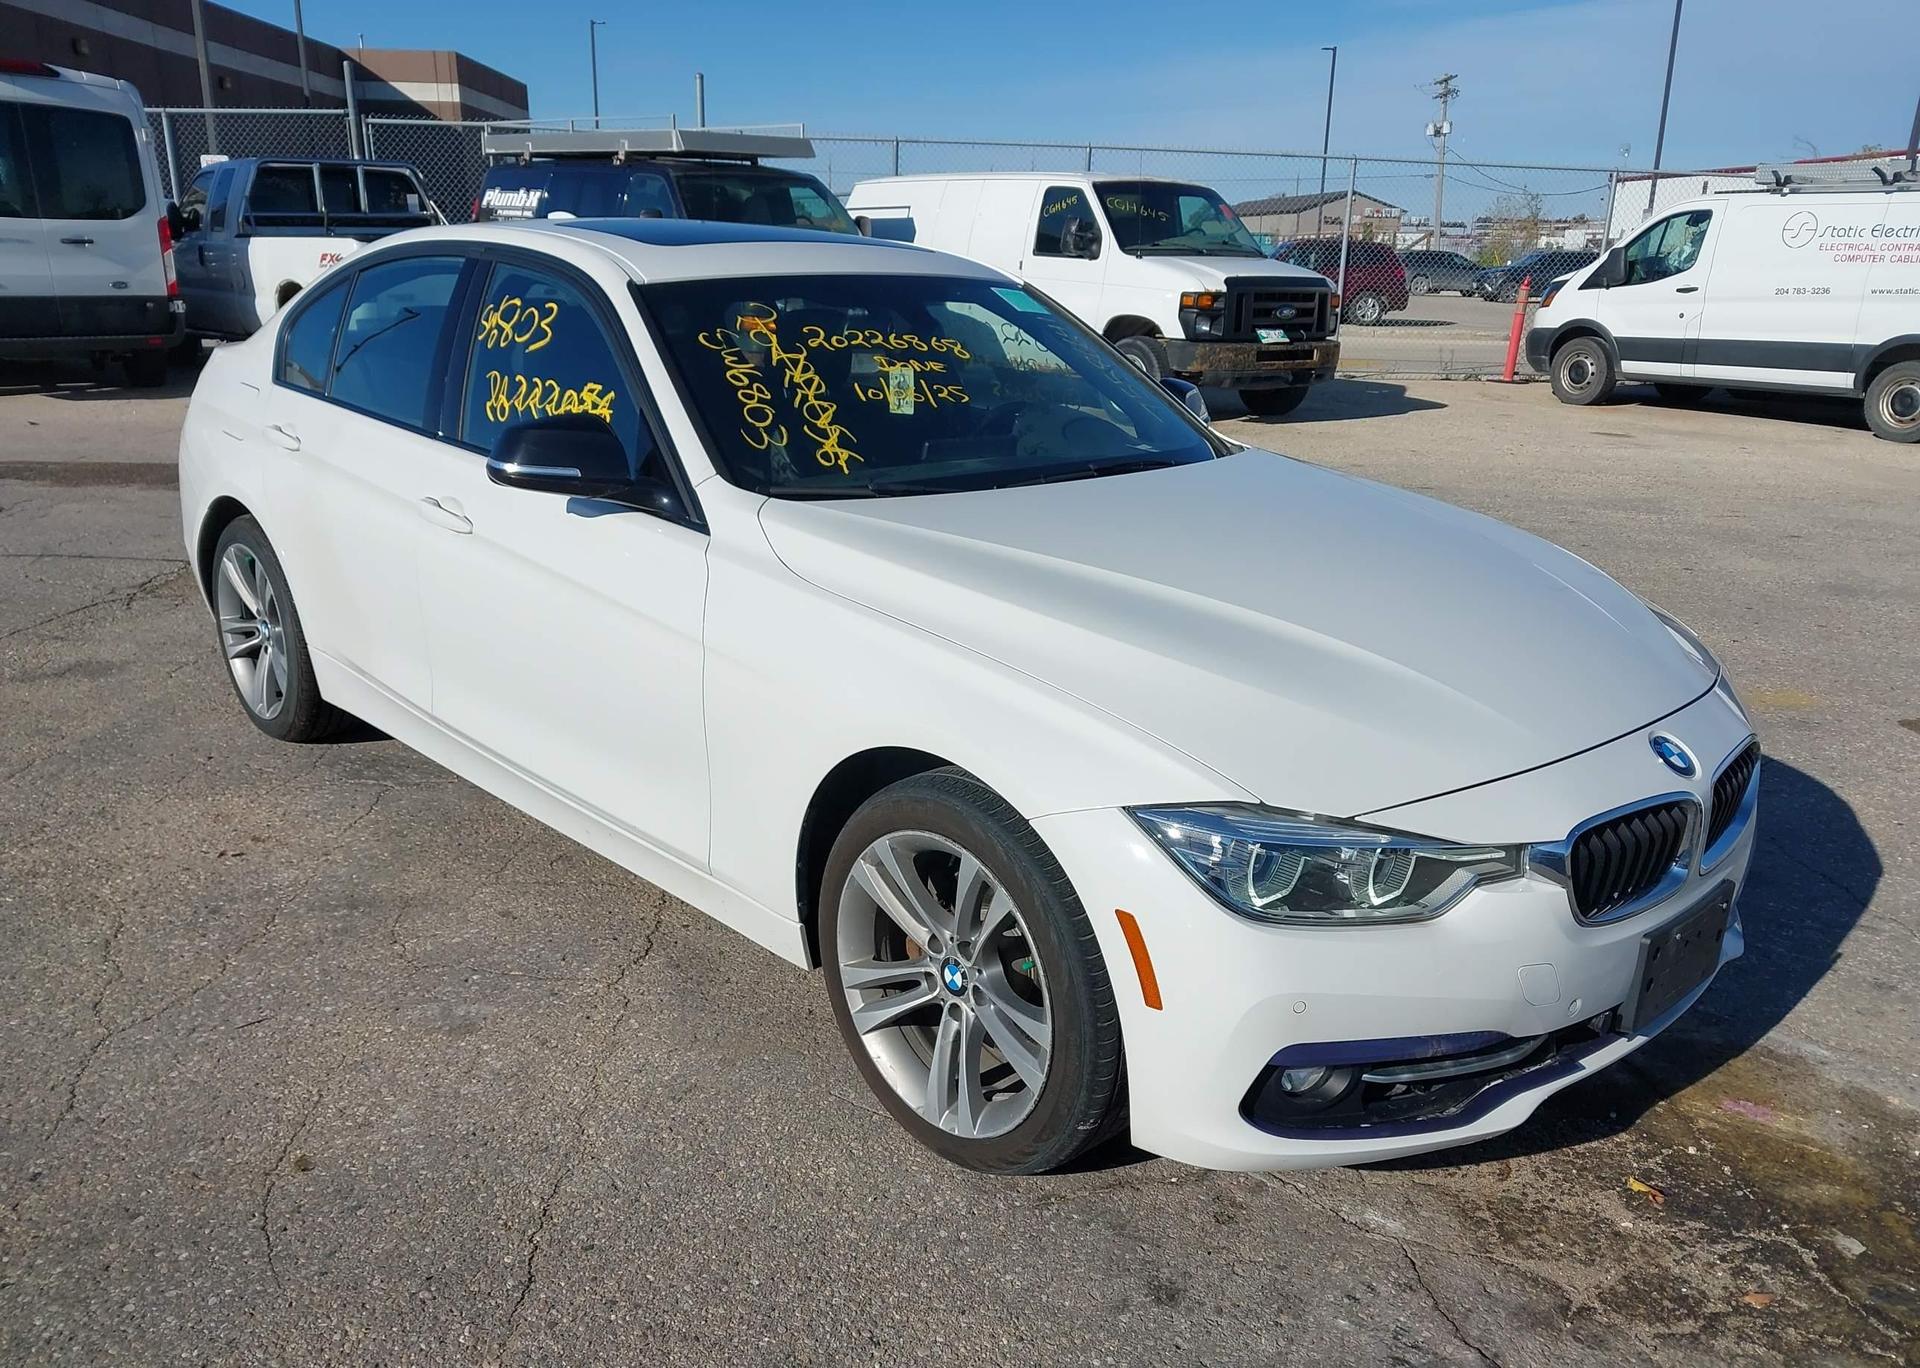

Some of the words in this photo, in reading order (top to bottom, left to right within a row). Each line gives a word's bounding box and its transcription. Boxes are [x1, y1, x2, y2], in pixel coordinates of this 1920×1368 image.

[1043, 195, 1078, 217] CGH645
[1819, 225, 1866, 238] Static
[1819, 243, 1876, 252] ELECTRICAL
[1833, 254, 1885, 263] COMPUTER
[802, 326, 973, 360] 20226868
[698, 328, 789, 449] SW6803
